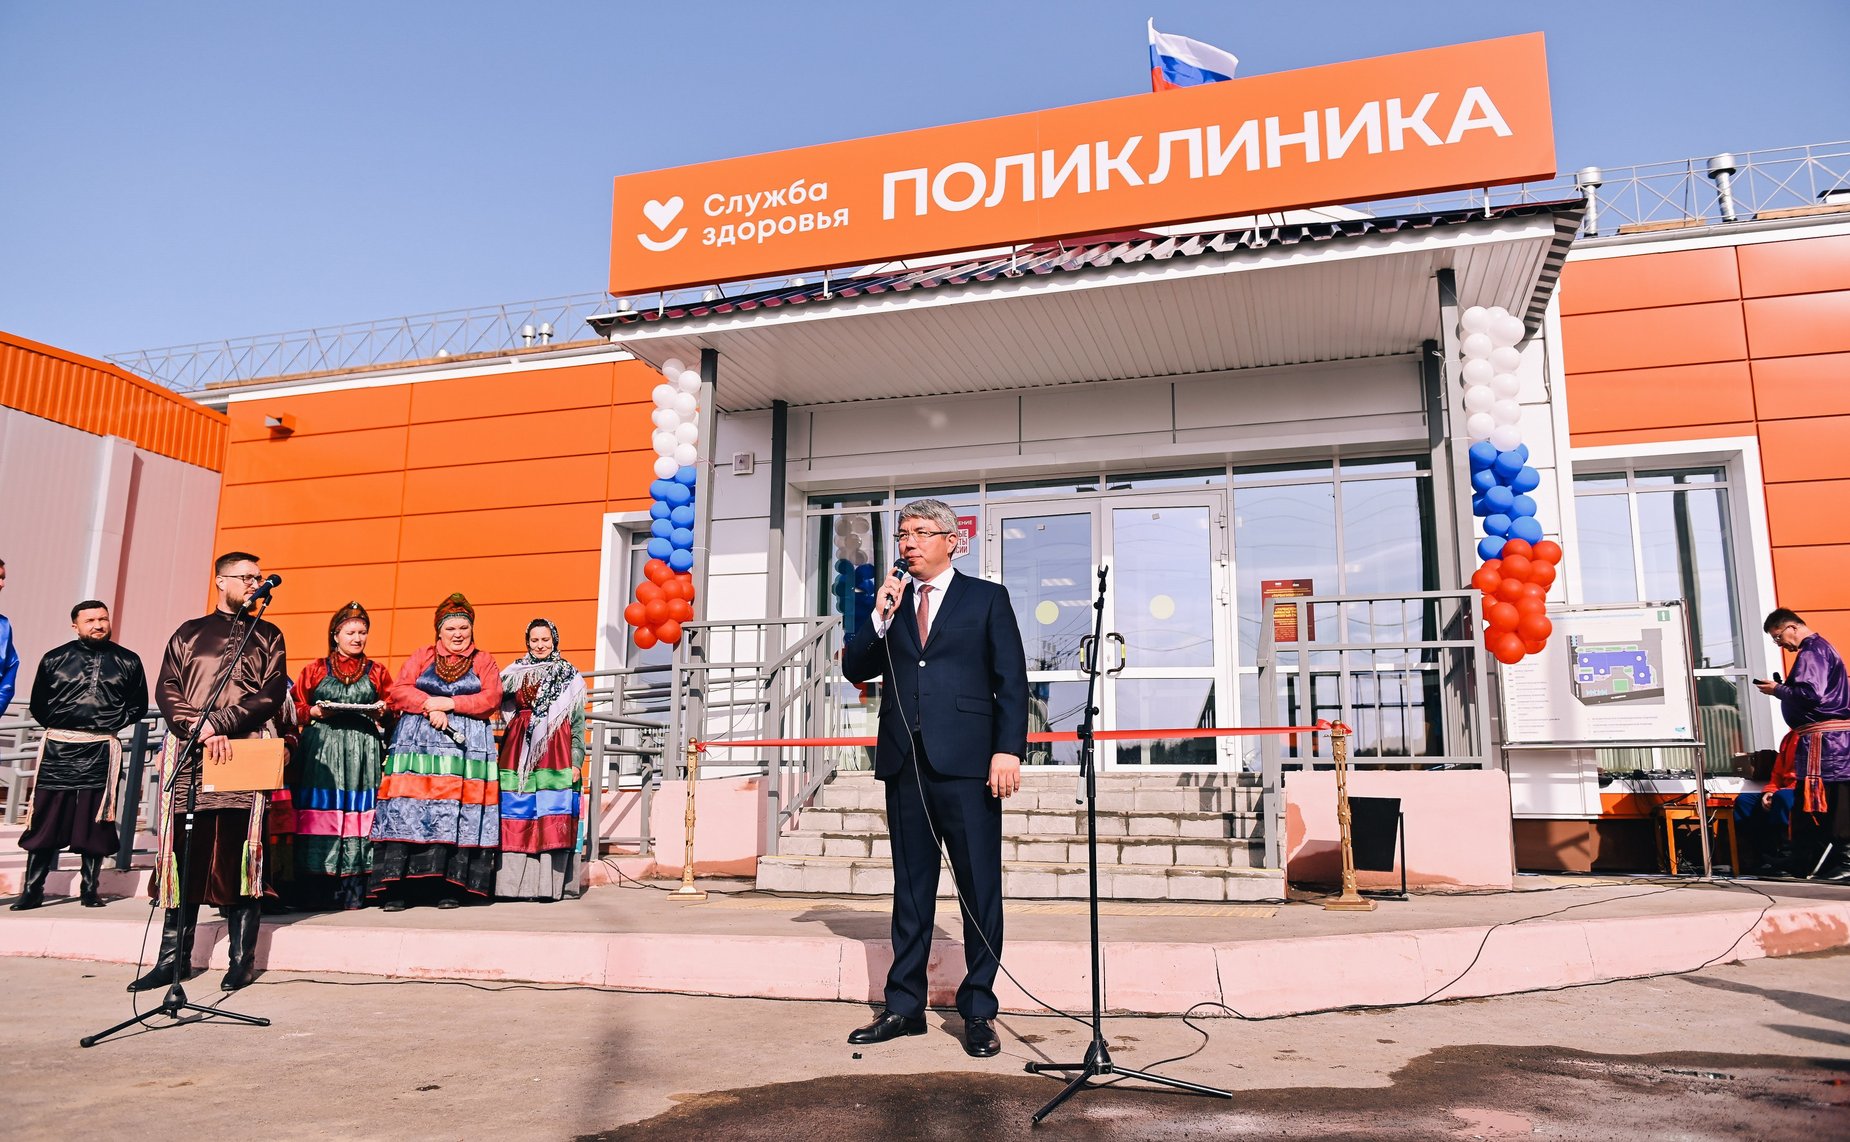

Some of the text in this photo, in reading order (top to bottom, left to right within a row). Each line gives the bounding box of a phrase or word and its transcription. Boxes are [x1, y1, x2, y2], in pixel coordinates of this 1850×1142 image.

[882, 86, 1513, 221] ПОЛИКЛИНИКА
[703, 178, 828, 217] Служба
[702, 207, 849, 247] здоровья
